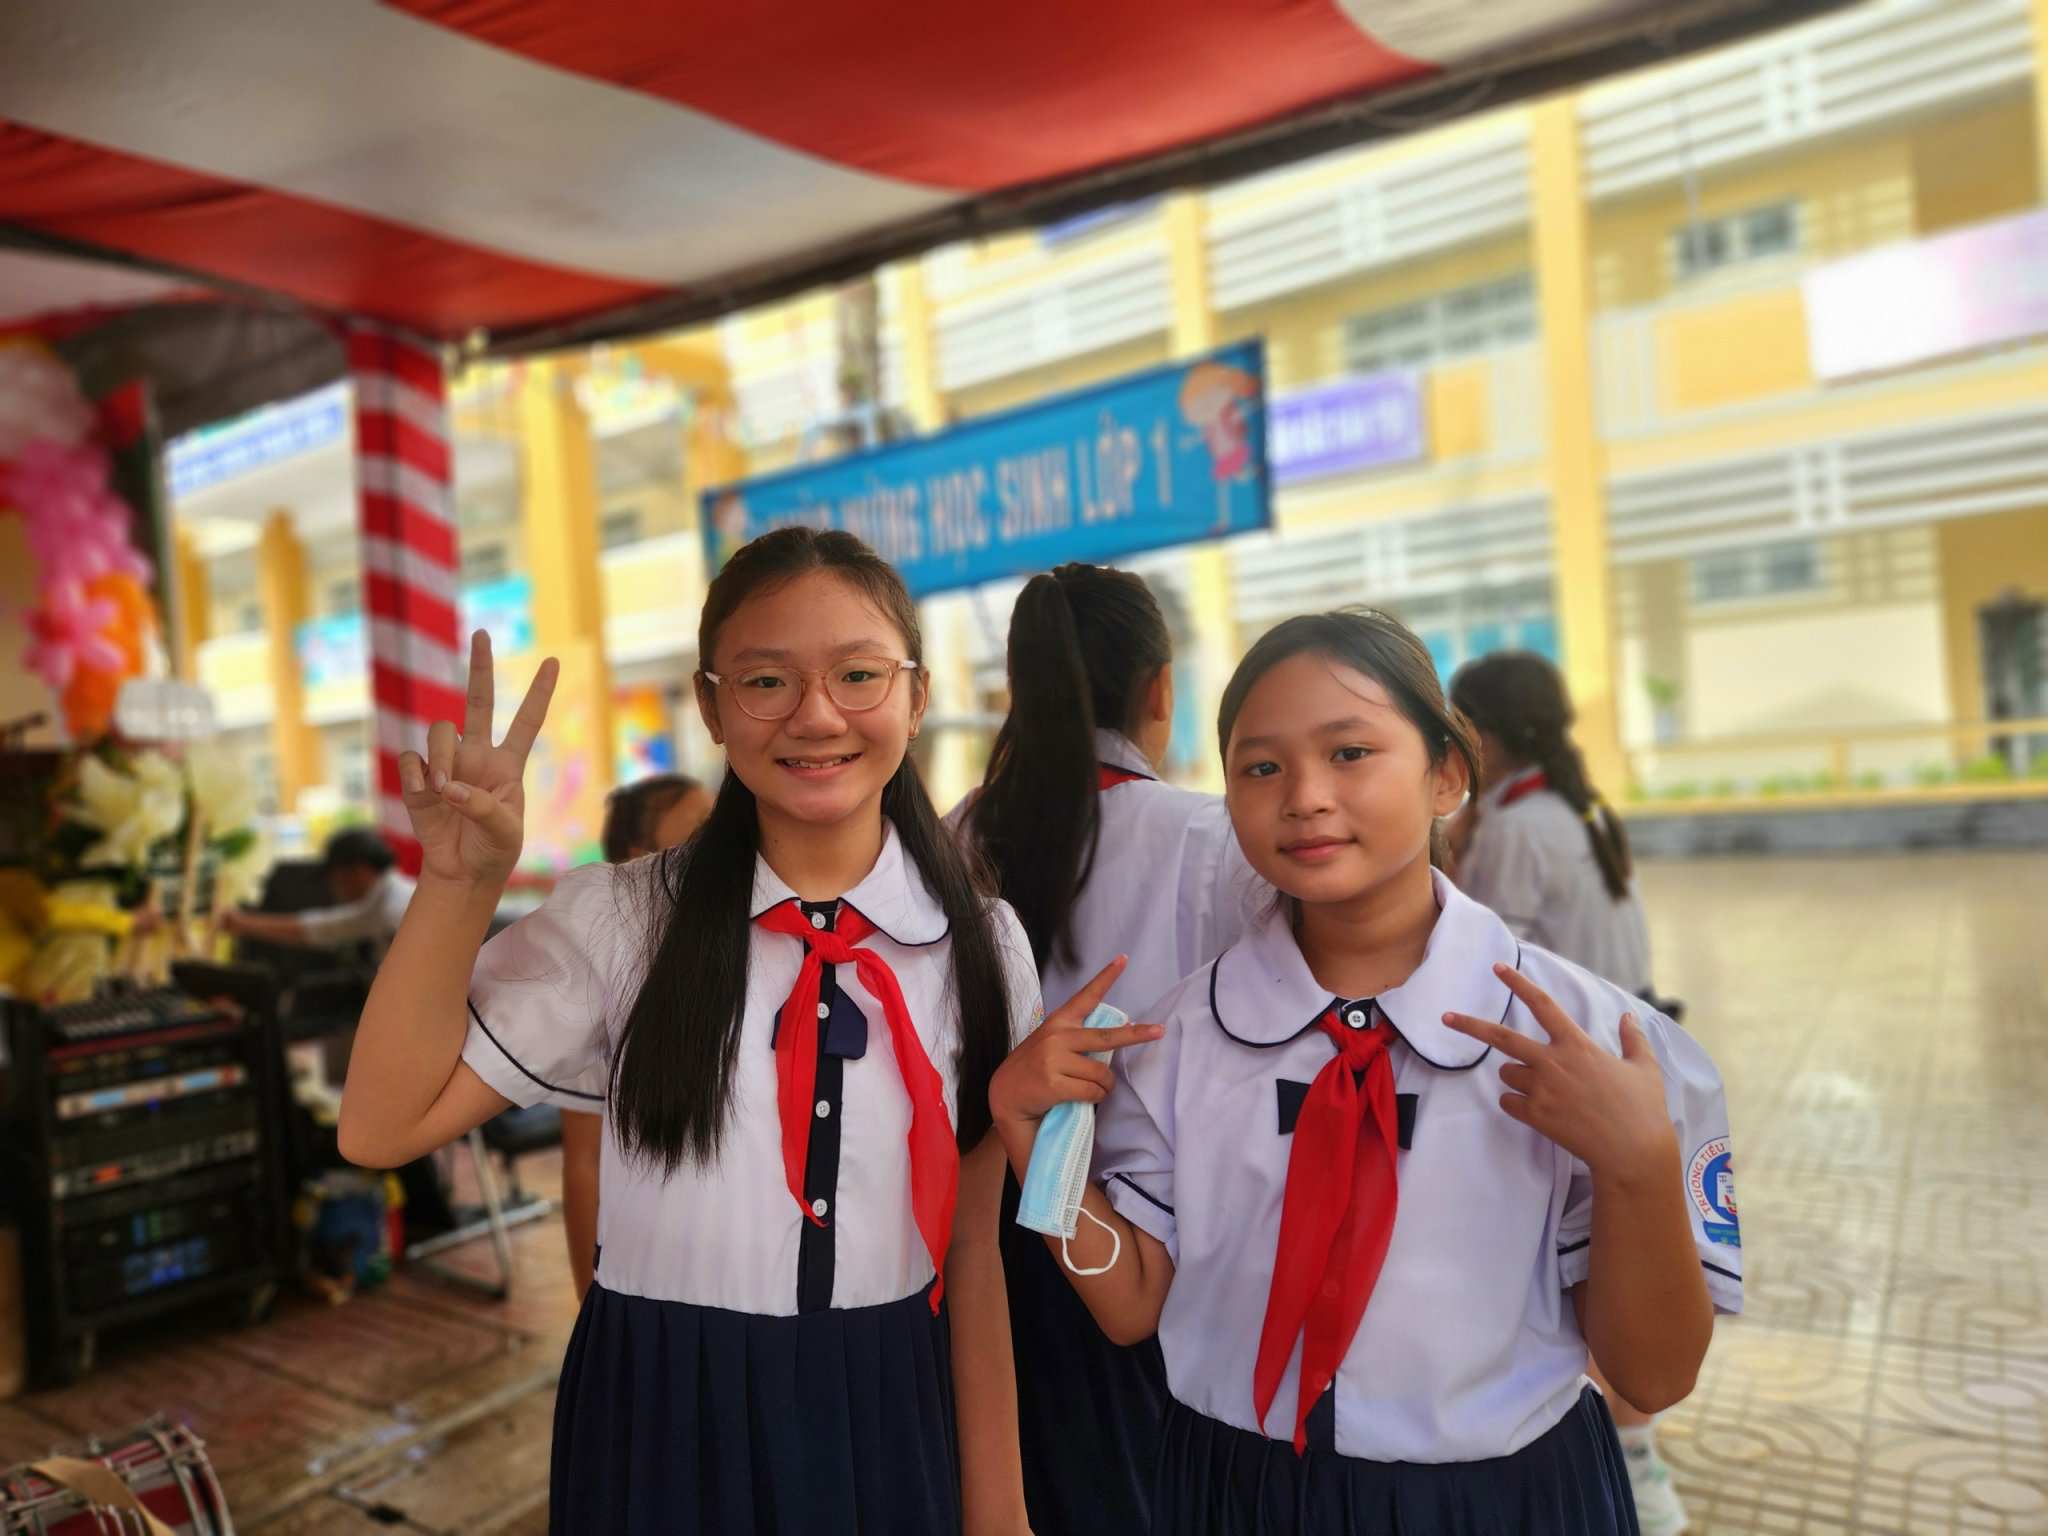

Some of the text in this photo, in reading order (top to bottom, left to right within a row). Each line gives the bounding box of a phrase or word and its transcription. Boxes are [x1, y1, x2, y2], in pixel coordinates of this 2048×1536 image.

[928, 467, 988, 572] HỌC
[997, 443, 1072, 541] SINH
[1076, 410, 1141, 523] LỚP
[1152, 421, 1173, 507] 1
